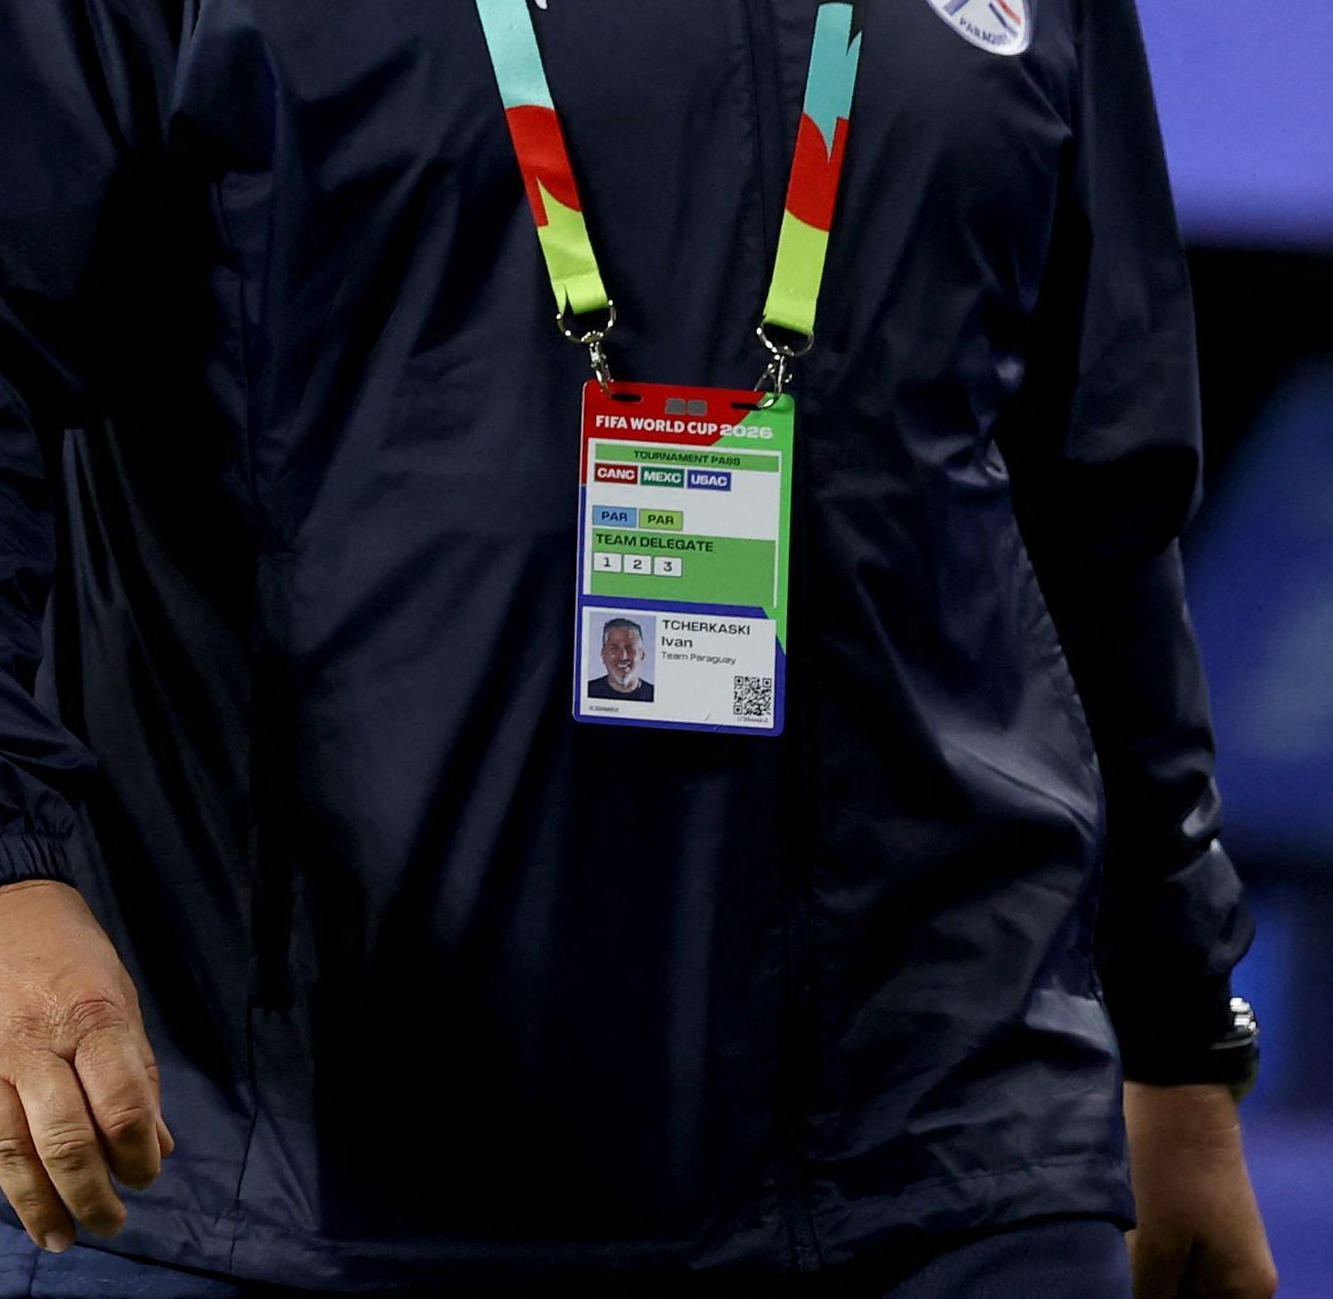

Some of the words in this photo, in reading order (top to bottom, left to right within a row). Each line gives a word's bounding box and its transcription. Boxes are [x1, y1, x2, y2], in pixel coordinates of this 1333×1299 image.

[595, 414, 629, 430] FIFA
[630, 417, 684, 433] WORLD
[687, 421, 718, 436] CUP
[719, 423, 774, 440] 2026
[634, 450, 710, 465] TOURNAMENT
[710, 456, 741, 466] PASS
[597, 467, 636, 480] CANC
[643, 470, 682, 483] MEXC
[691, 473, 728, 486] USAC
[601, 510, 629, 522] PAR
[647, 514, 675, 526] PAR
[596, 532, 637, 547] TEAM
[640, 536, 714, 552] DELEGATE
[603, 556, 612, 568] 1
[632, 558, 643, 570] 2
[662, 561, 673, 572] 3
[661, 619, 751, 636] TCHERKASKI
[661, 635, 693, 648] Ivan
[661, 651, 689, 661] Team
[689, 653, 737, 665] Paraguay
